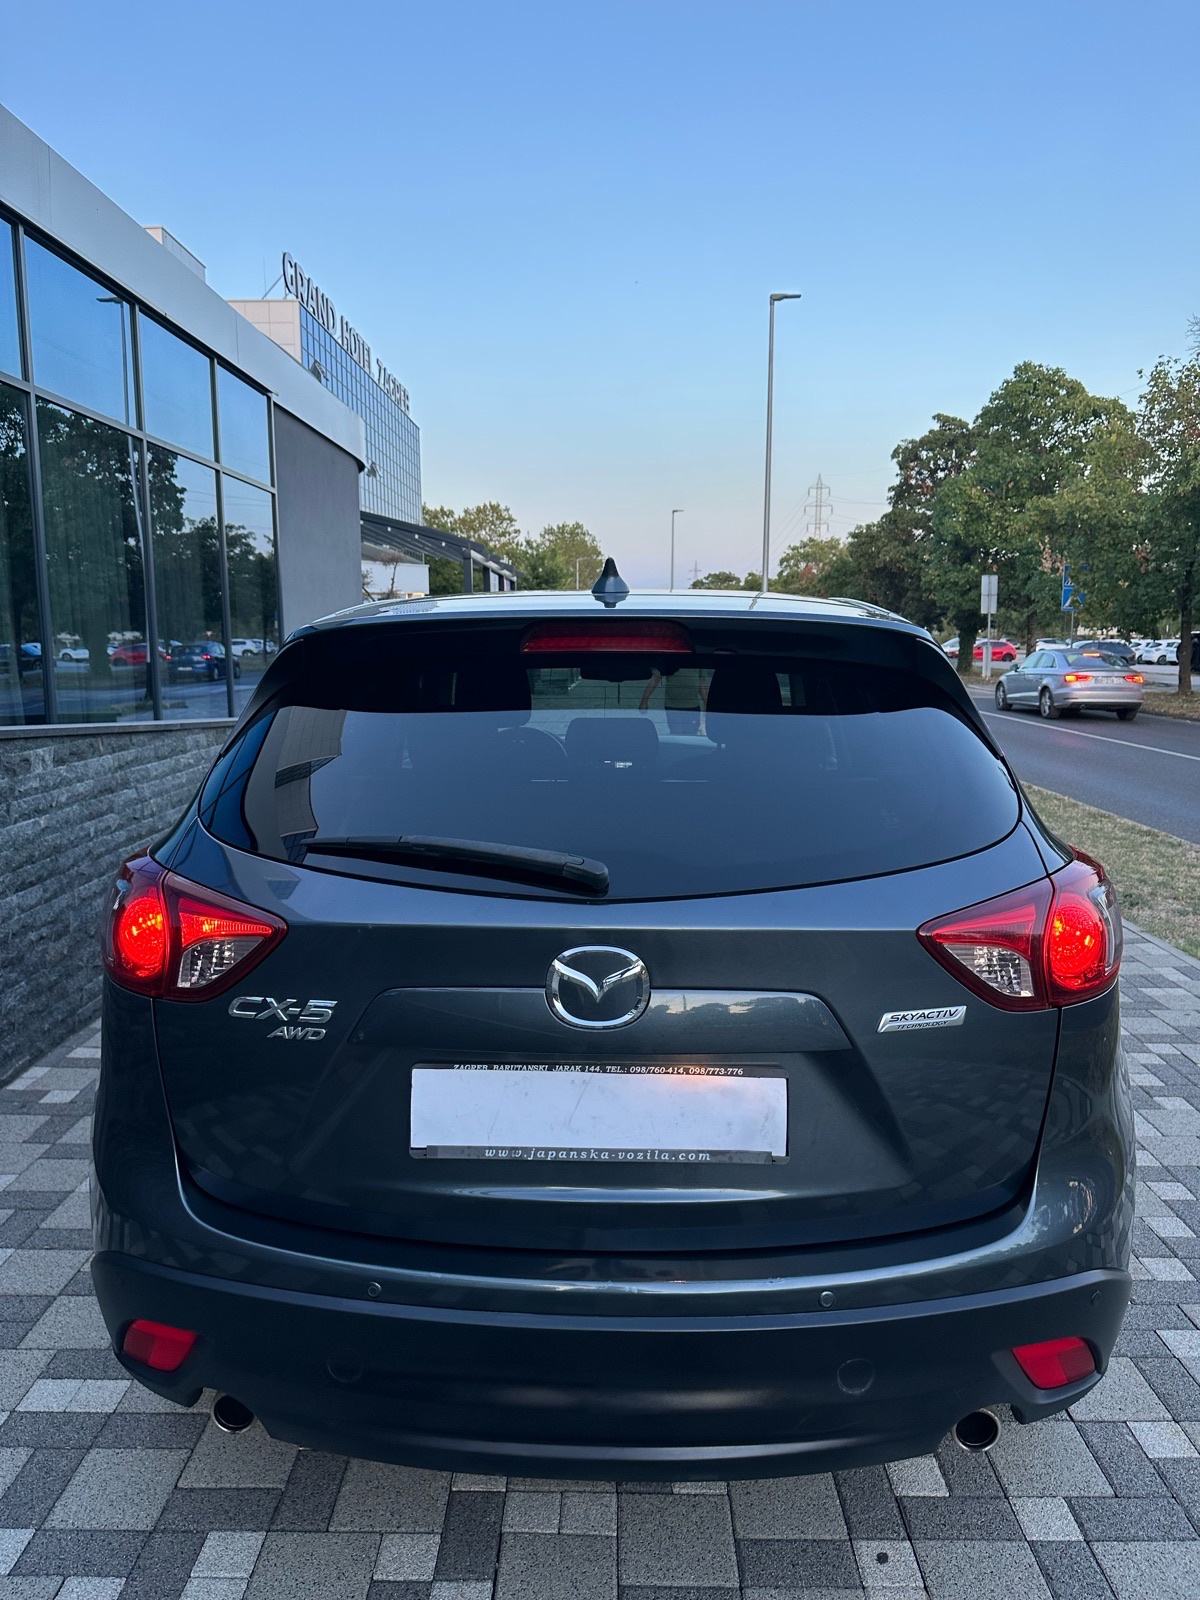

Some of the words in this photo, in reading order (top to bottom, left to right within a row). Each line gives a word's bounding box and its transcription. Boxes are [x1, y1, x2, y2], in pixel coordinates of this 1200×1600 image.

[282, 251, 337, 336] GRAND
[340, 315, 371, 376] HOTEL
[228, 996, 338, 1024] CX-5
[888, 1008, 958, 1022] SKYACTIV
[897, 1020, 949, 1029] TECHNOLOGY
[266, 1026, 327, 1041] AWD
[689, 1067, 744, 1076] 098/773-776
[484, 1148, 711, 1161] www.japanska-vozila.com
